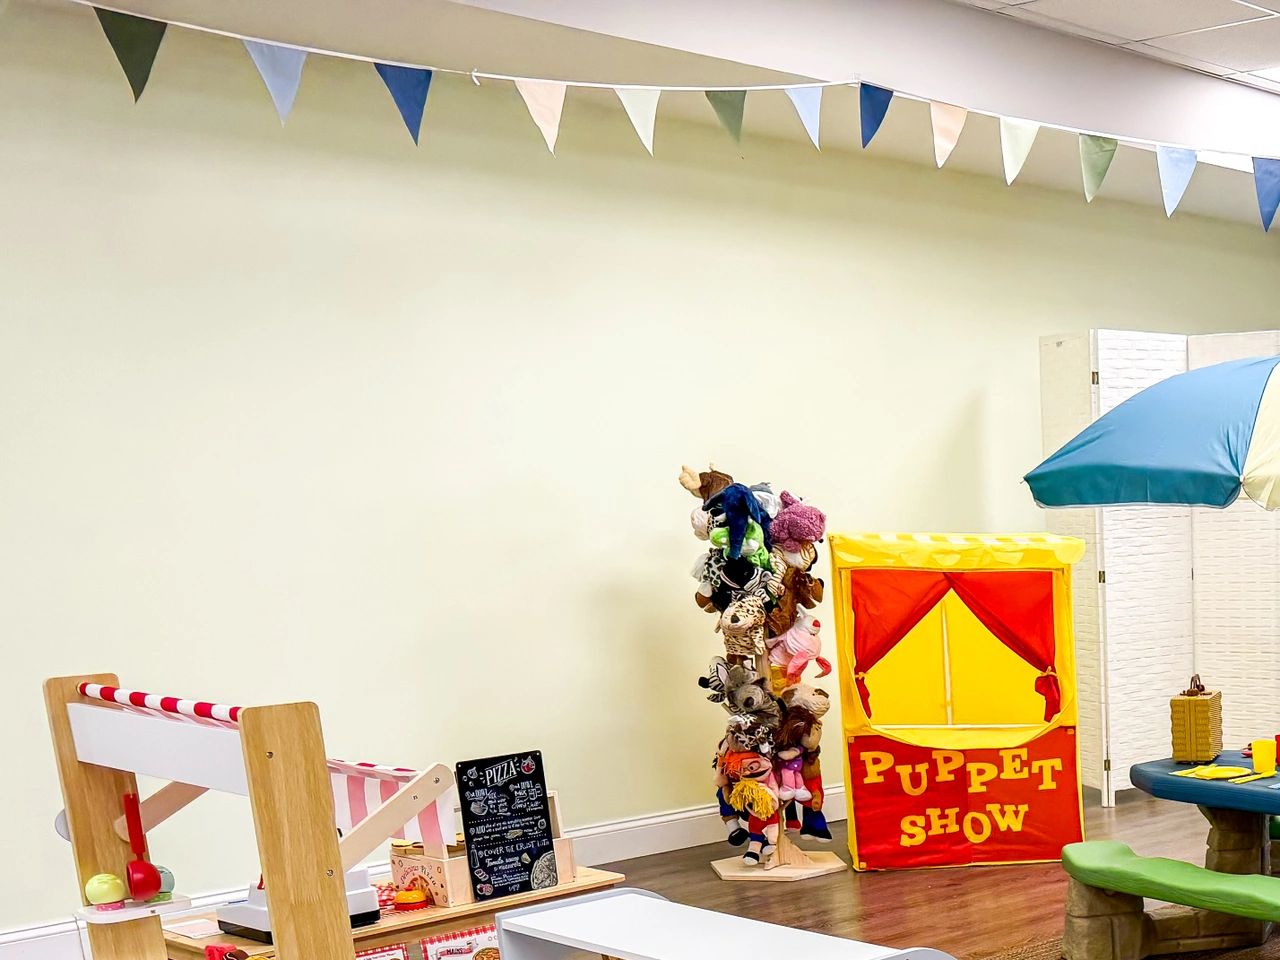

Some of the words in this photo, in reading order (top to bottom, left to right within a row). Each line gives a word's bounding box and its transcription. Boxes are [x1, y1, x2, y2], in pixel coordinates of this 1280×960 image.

[486, 760, 517, 786] PIZZA
[860, 748, 1062, 796] PUPPET
[899, 803, 1029, 848] SHOW
